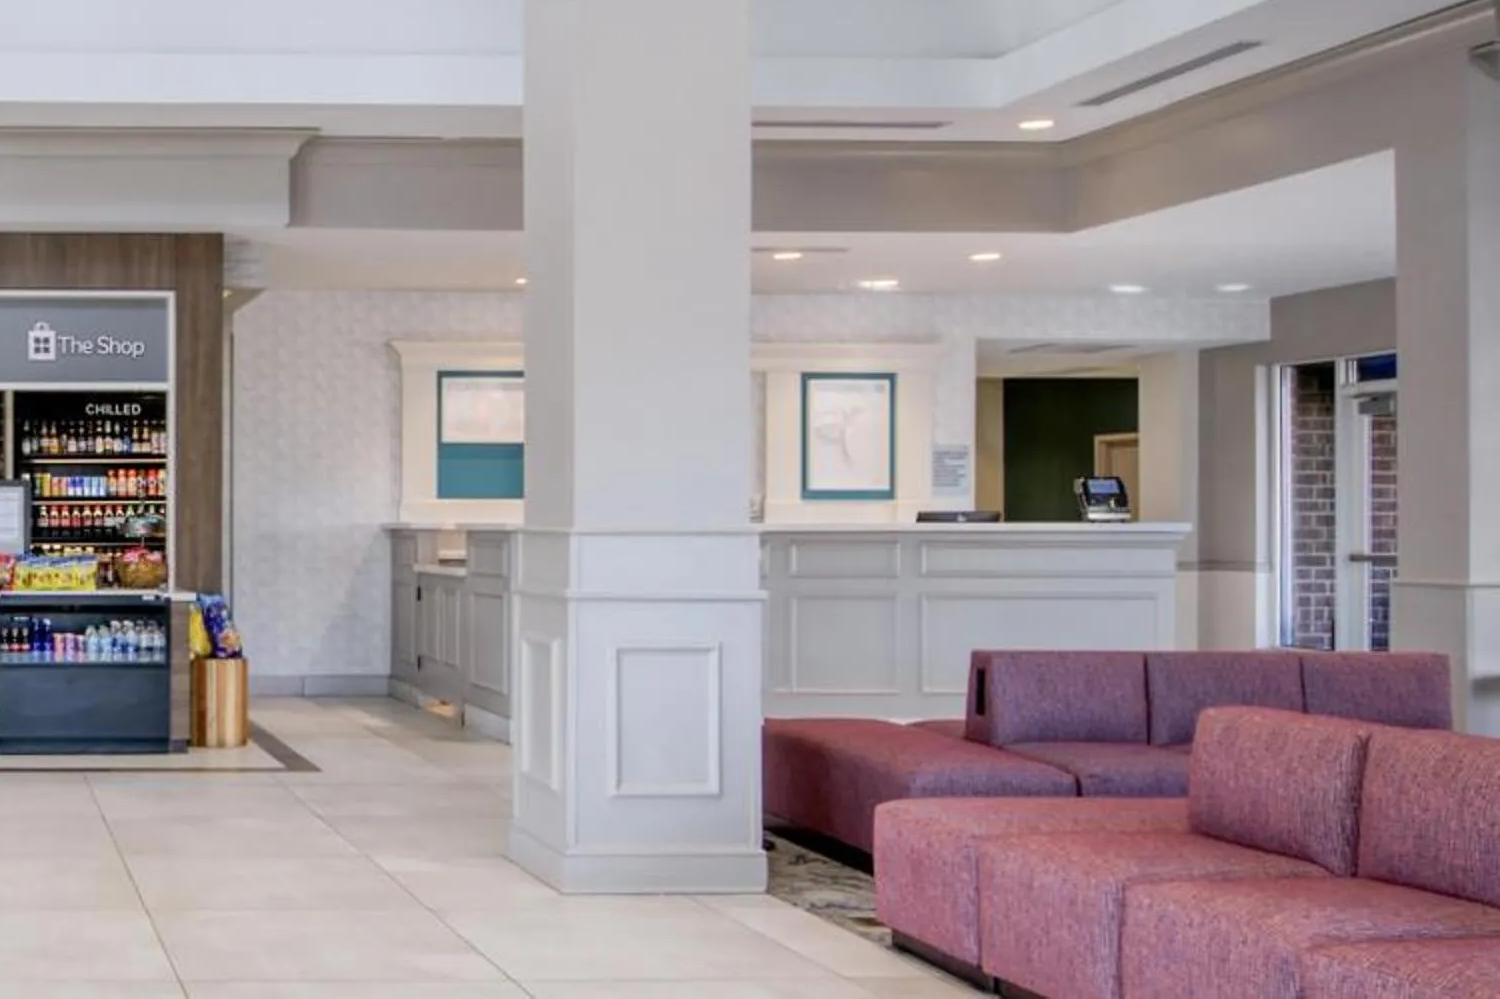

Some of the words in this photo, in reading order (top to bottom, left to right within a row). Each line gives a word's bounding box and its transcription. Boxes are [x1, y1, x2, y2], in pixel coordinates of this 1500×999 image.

[57, 335, 94, 354] The
[97, 335, 146, 358] Shop
[85, 403, 142, 416] CHILLED
